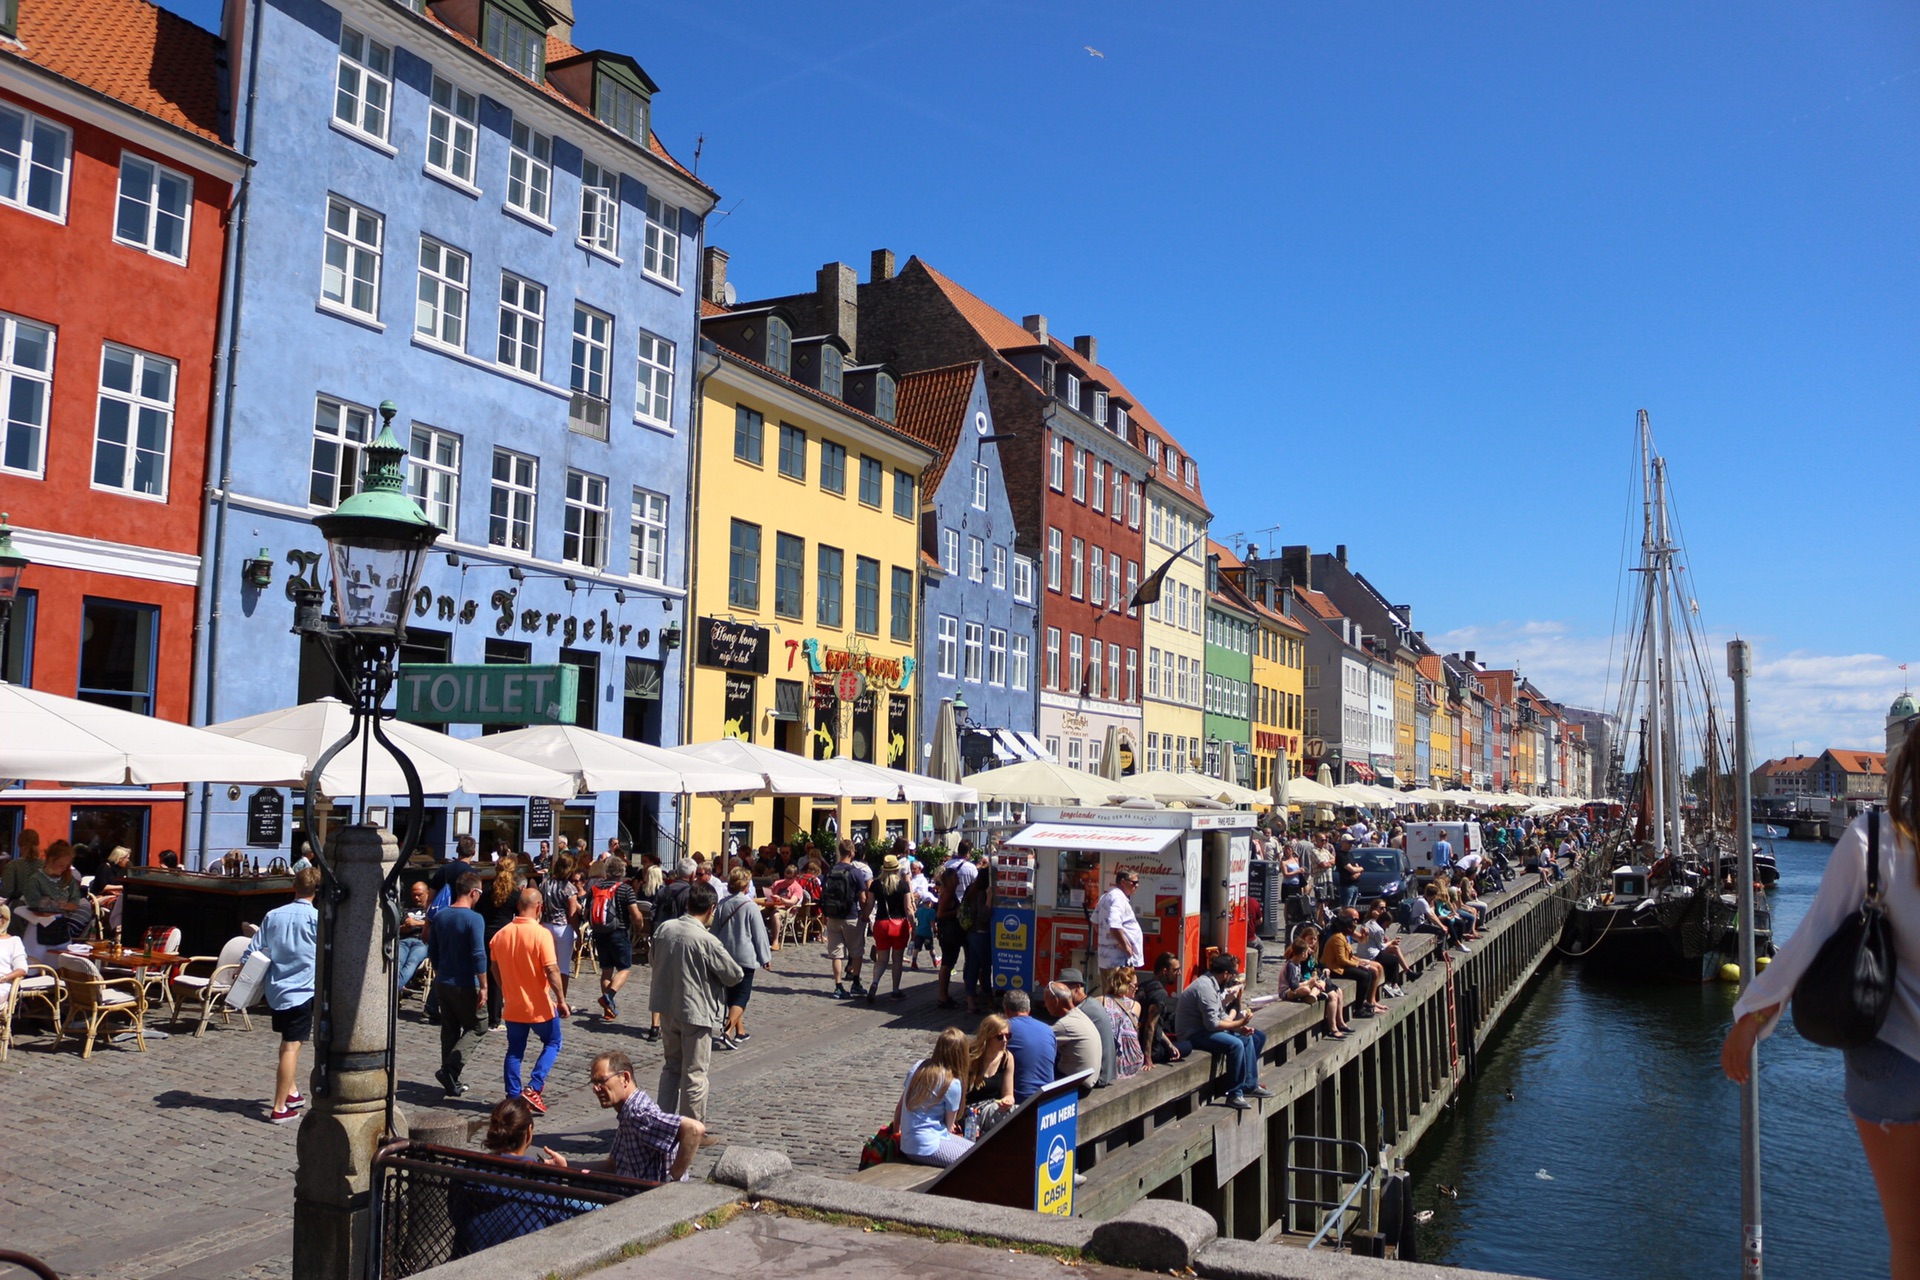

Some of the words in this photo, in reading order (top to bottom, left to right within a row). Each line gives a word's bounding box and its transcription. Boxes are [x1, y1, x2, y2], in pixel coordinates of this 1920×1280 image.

[711, 621, 738, 650] Hong
[785, 639, 799, 671] 7
[405, 672, 556, 714] TOILET
[1307, 740, 1324, 757] 17
[1000, 933, 1022, 941] CASH
[1040, 1112, 1057, 1131] ATM
[1058, 1103, 1076, 1123] HERE
[1044, 1182, 1067, 1206] CASH
